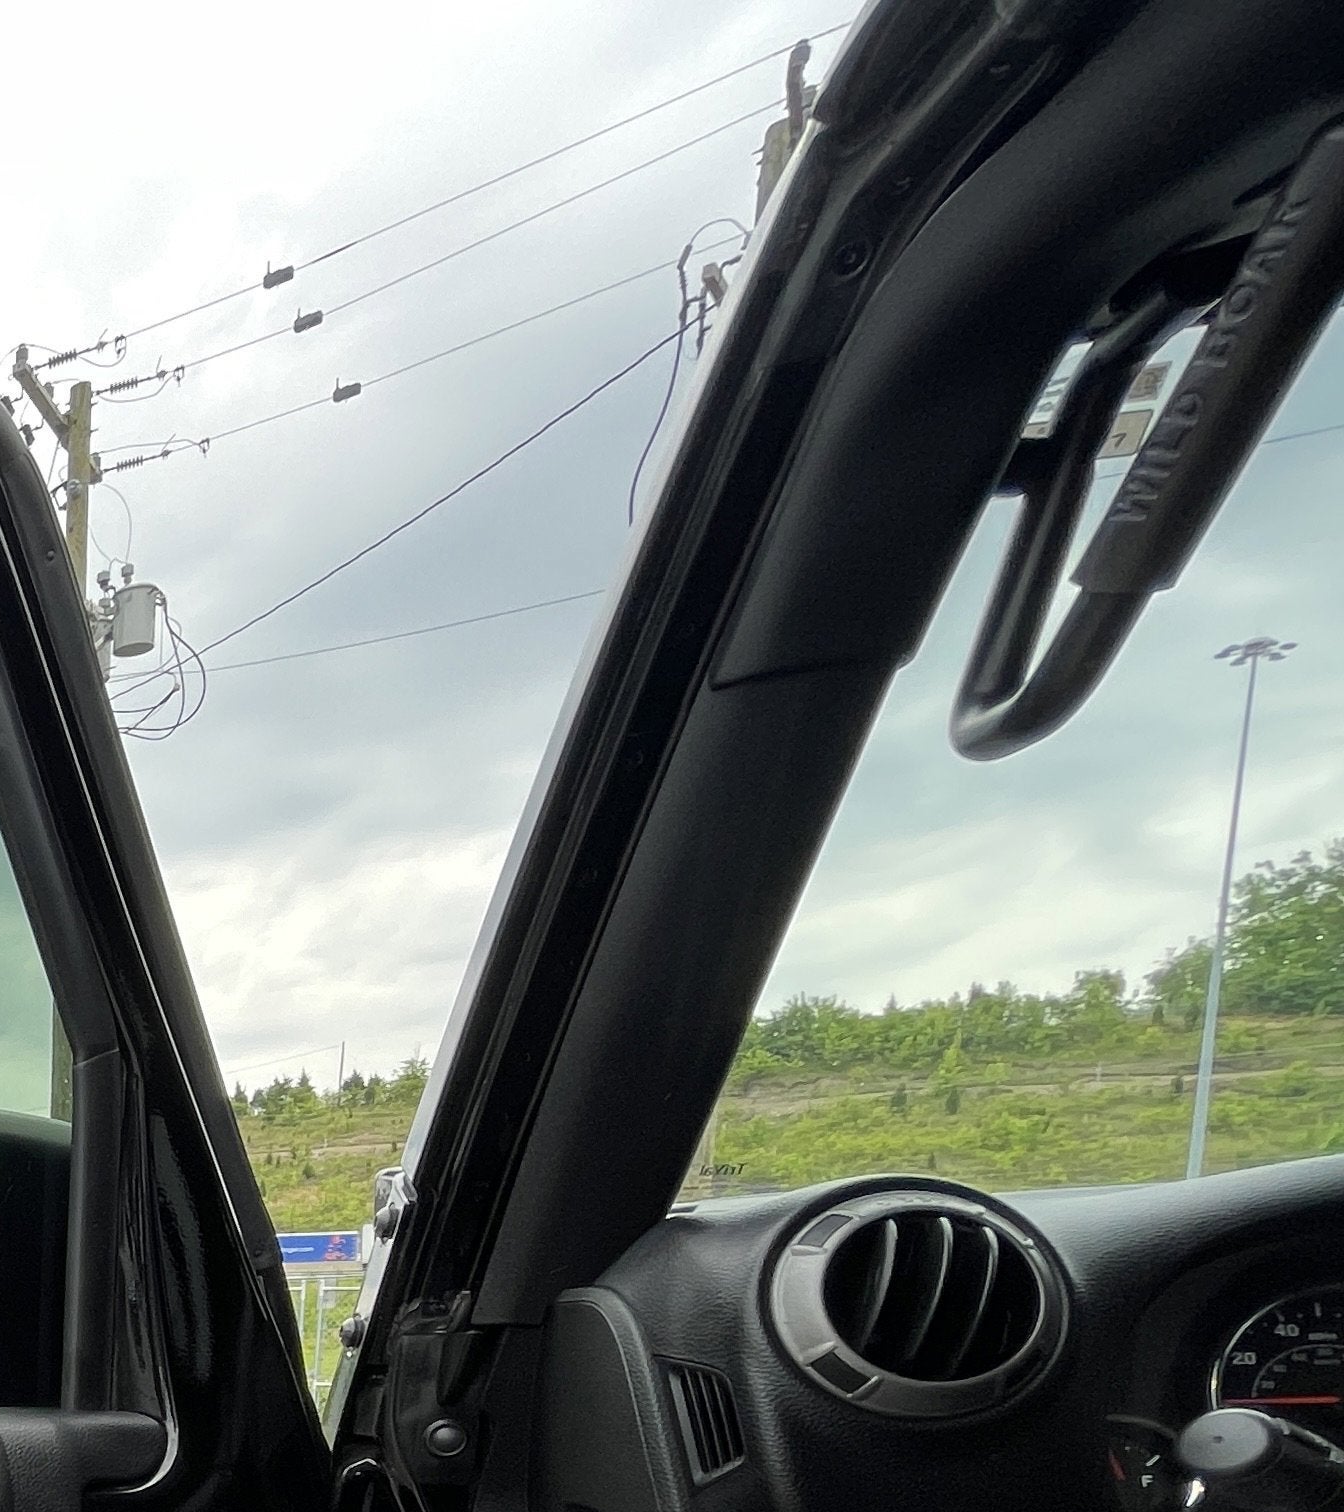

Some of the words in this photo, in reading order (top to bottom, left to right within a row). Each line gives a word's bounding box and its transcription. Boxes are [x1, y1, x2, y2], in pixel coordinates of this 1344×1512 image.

[1108, 393, 1201, 522] WILD
[1190, 201, 1309, 369] BOAR
[1273, 1323, 1300, 1338] 40
[1230, 1351, 1257, 1365] 20
[1139, 1474, 1154, 1488] F
